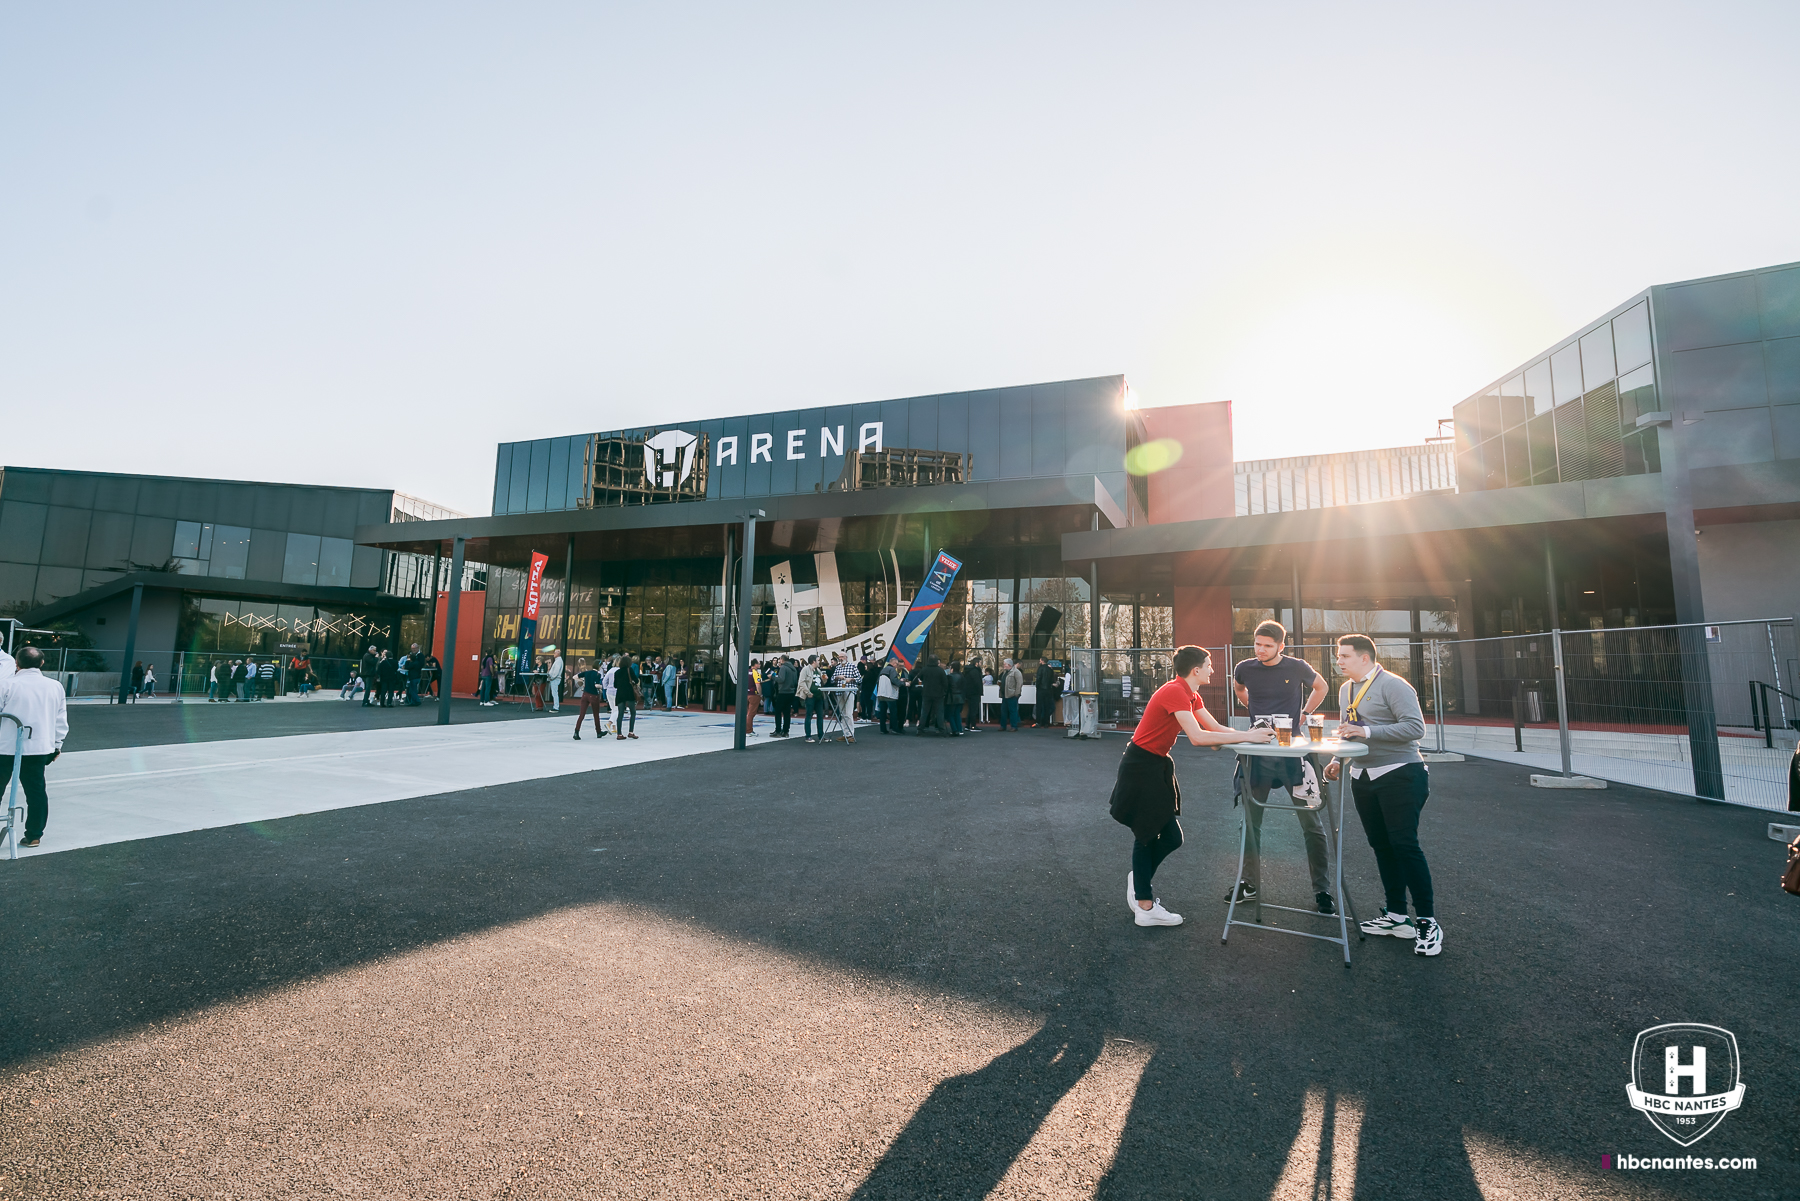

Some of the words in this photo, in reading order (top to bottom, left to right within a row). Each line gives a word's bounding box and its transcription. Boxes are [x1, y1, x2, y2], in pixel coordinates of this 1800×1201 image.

[716, 421, 884, 467] ARENA
[527, 560, 543, 616] VELUX
[539, 614, 593, 640] OFFCIEL
